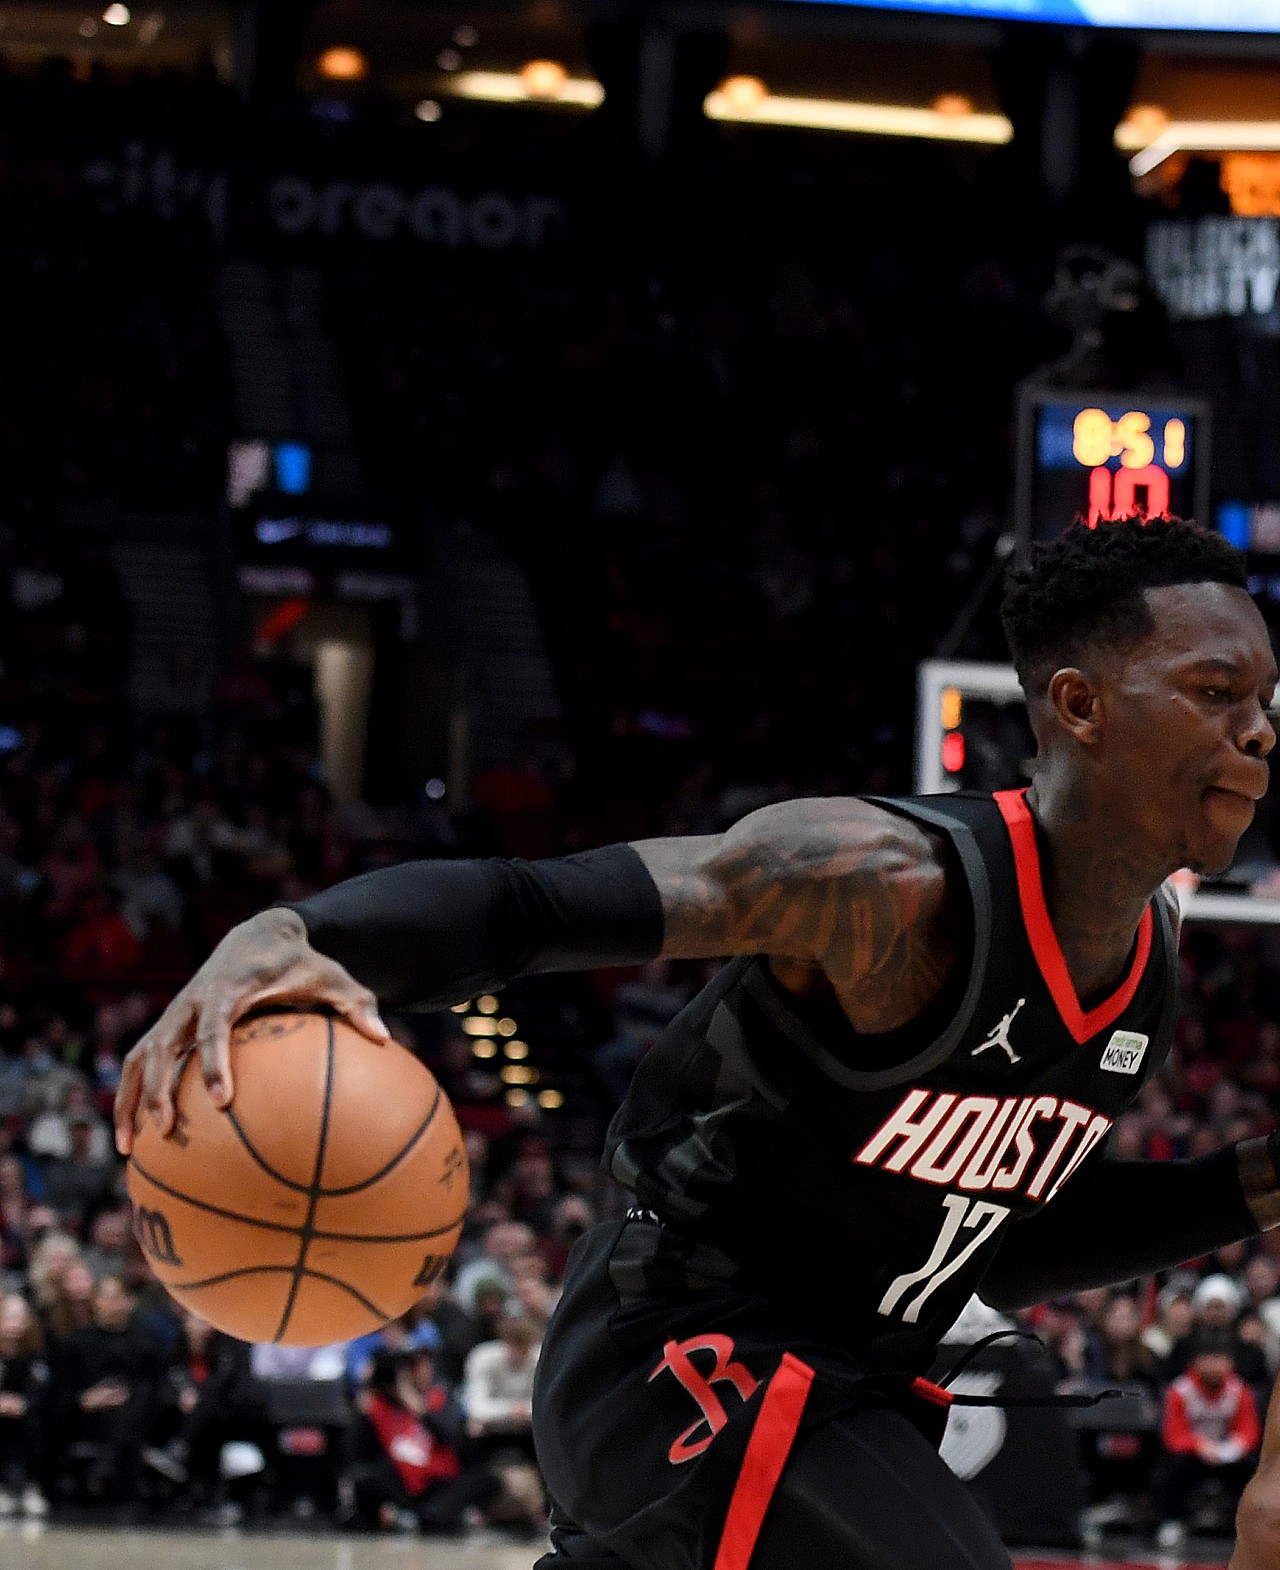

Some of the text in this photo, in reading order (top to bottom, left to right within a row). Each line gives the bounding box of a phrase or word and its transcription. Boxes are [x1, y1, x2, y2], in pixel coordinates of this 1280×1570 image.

[1103, 1048, 1139, 1069] MONEY
[853, 1088, 1113, 1203] HOUSTO
[877, 1193, 1011, 1324] 17
